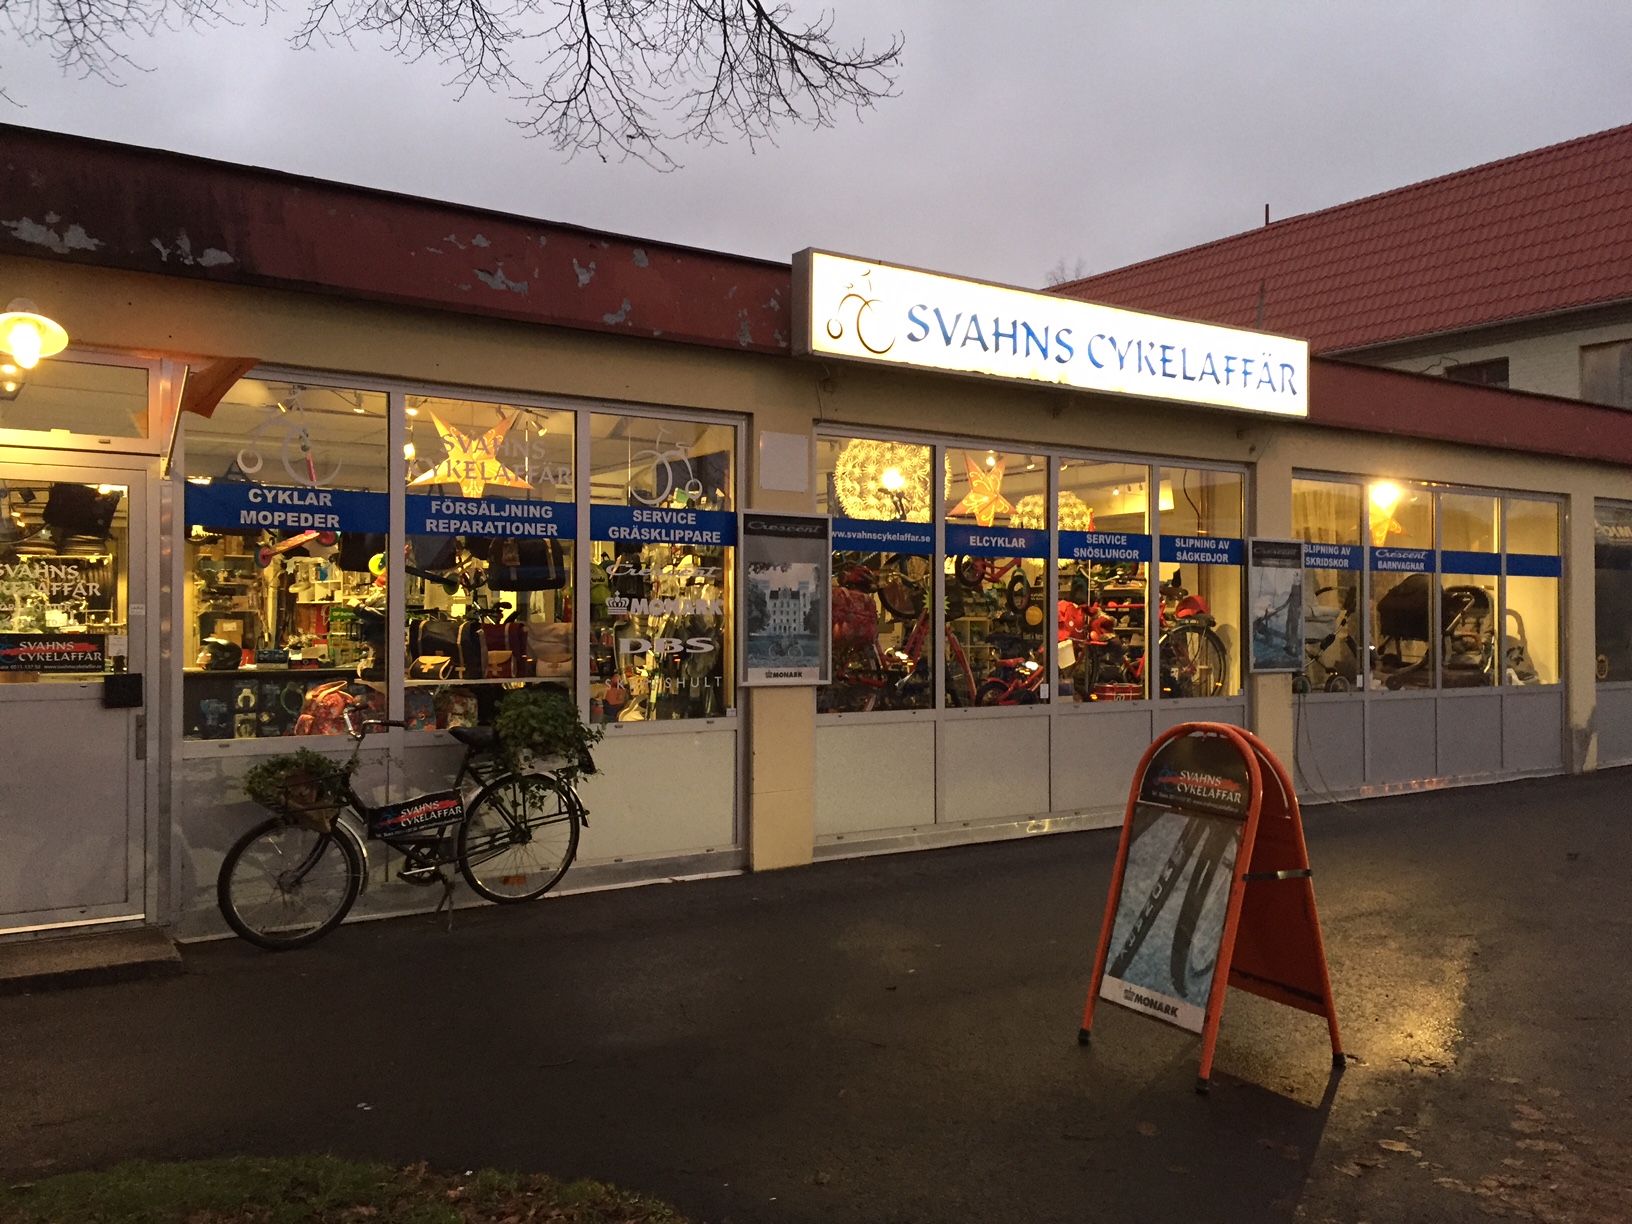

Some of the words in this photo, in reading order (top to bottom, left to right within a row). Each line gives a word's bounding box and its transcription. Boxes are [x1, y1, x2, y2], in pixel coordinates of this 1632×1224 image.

[906, 303, 1075, 365] SVAHNS
[1087, 333, 1298, 397] CYKELAFFÄR
[439, 433, 547, 461] SVAHNS
[409, 457, 573, 485] CYKELAFFÄR
[248, 488, 333, 507] CYKLAR
[431, 499, 553, 518] FÖRSÄLJNING
[240, 510, 340, 528] MOPEDER
[632, 509, 696, 525] SERVICE
[425, 519, 558, 536] REPARATIONER
[608, 525, 721, 543] GRÄSKLIPPARE
[747, 521, 823, 533] Crescent
[831, 530, 931, 543] ww.svahnscykelaffar.se
[969, 535, 1026, 548] ELCYKLAR
[1086, 534, 1127, 546] SERVICE
[1175, 538, 1216, 550] SLIPNING
[1217, 540, 1230, 550] AV
[1073, 546, 1140, 560] SNÖSLUNGOR
[1176, 549, 1229, 563] SÅGKEDJOR
[1304, 544, 1339, 555] SLIPNING
[1340, 547, 1351, 556] AV
[1375, 549, 1429, 560] Crescent
[1305, 556, 1349, 568] SKRIDSKOR
[1377, 560, 1425, 571] BARNVAGNAR
[606, 563, 722, 578] Creent
[630, 598, 723, 615] MONARK
[19, 641, 75, 651] SVAHNS
[619, 637, 715, 654] DBS
[18, 650, 102, 662] CYKELAFFÄR
[773, 671, 803, 679] MONARK
[604, 676, 723, 691] SKPSHULT
[1179, 770, 1222, 787] SVAHNS
[1177, 783, 1242, 804] CYKELAFFÄR
[400, 801, 440, 818] SVAHNS
[1133, 992, 1178, 1018] MONARK
